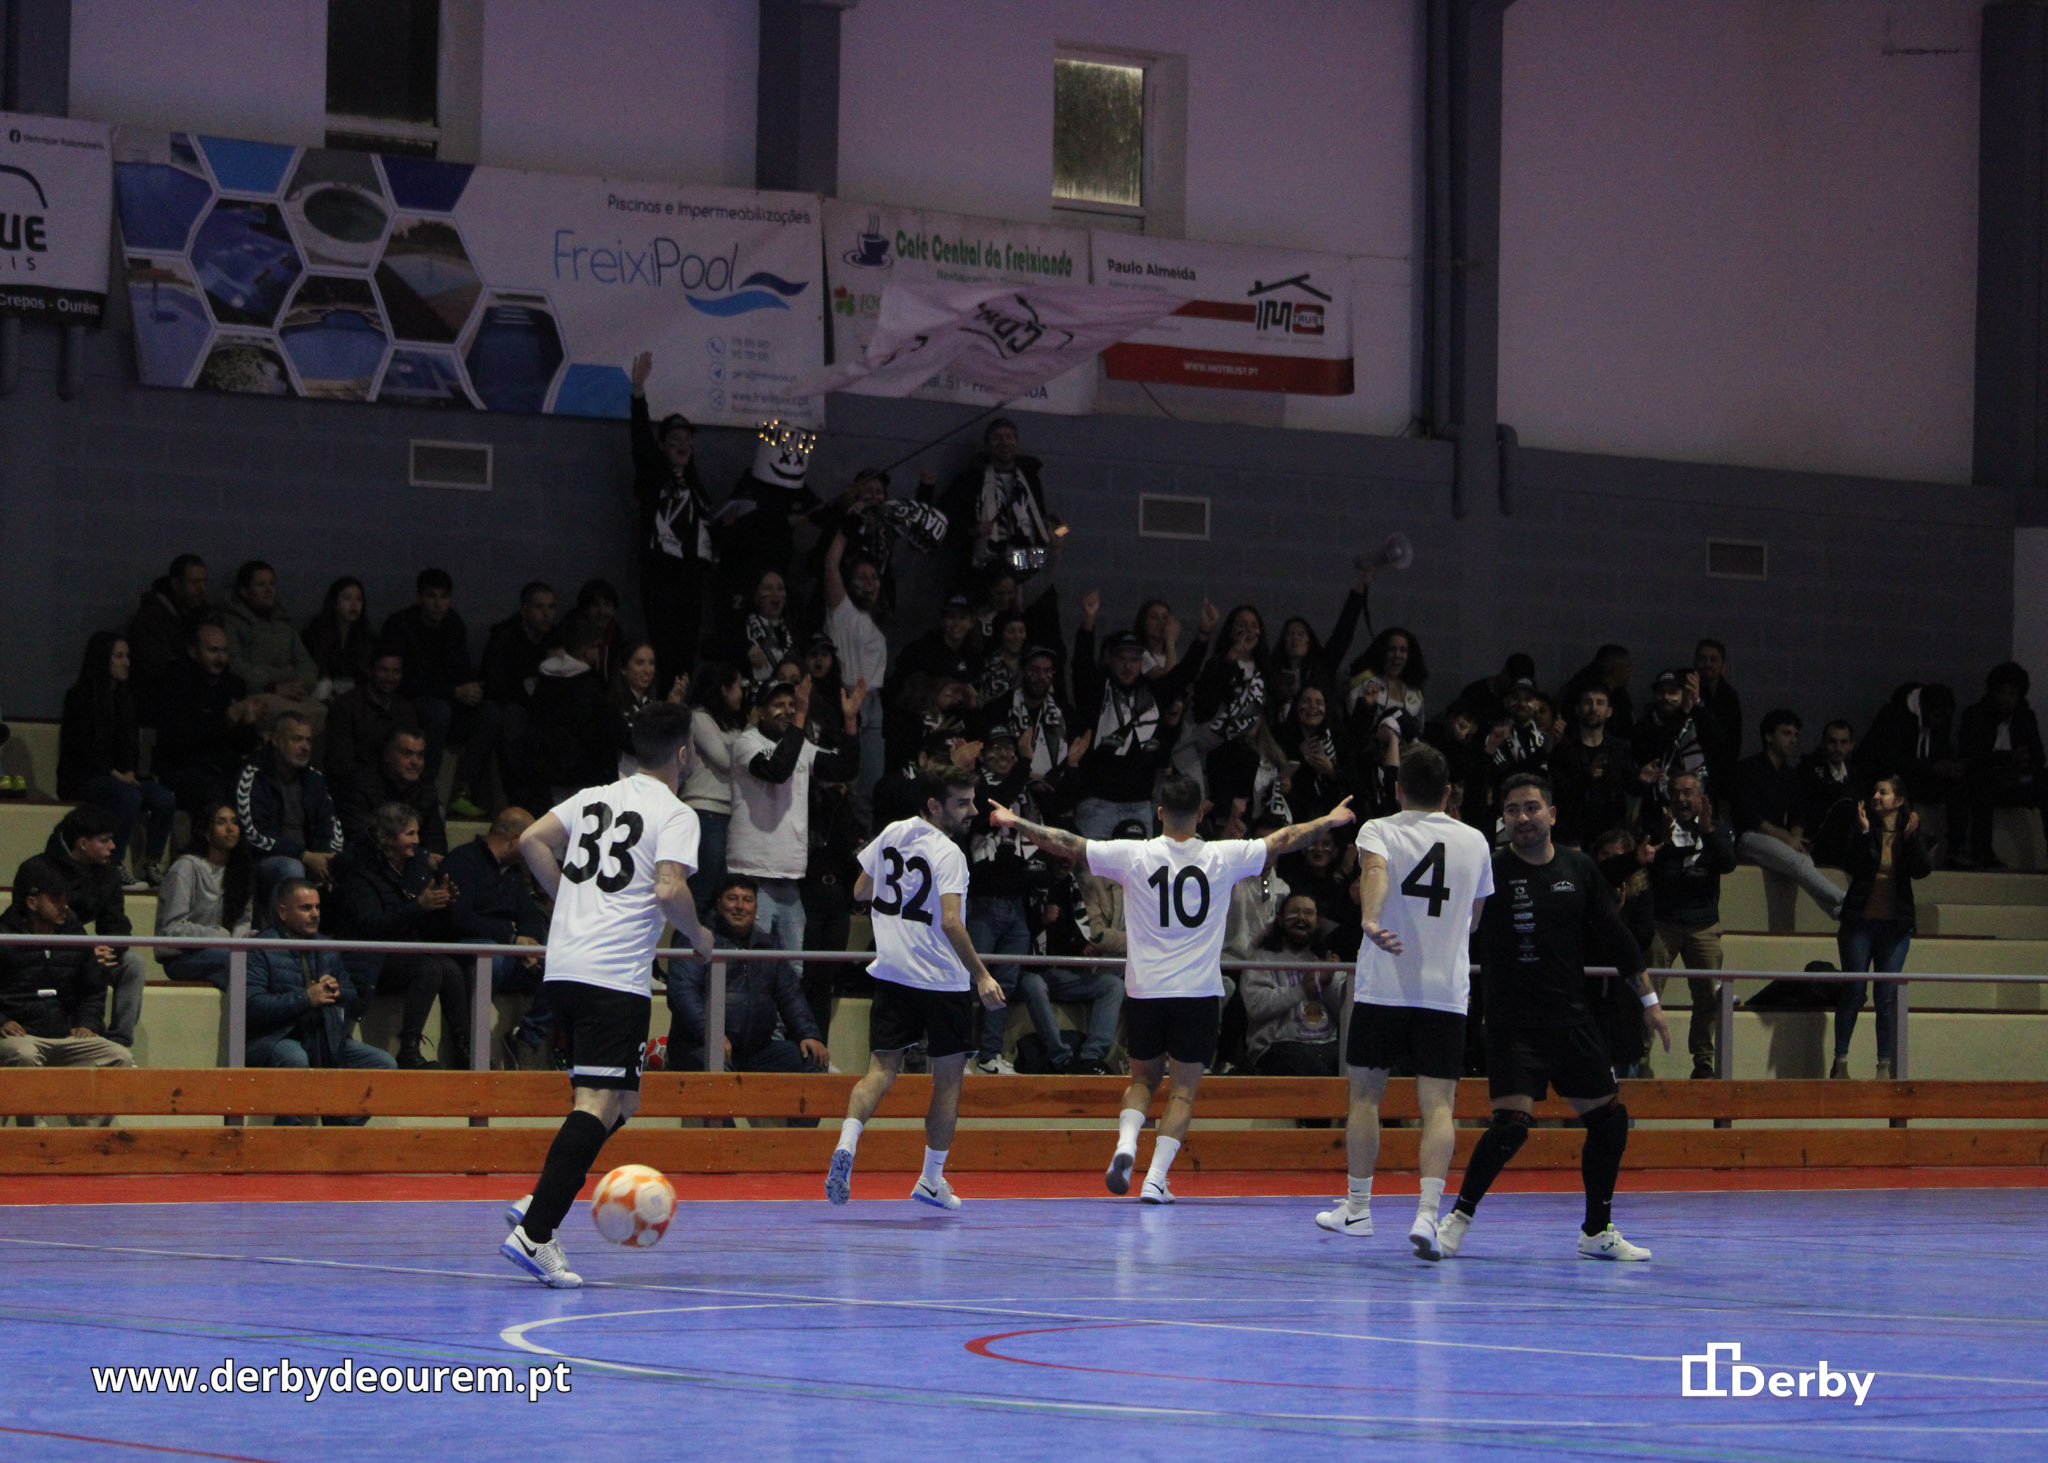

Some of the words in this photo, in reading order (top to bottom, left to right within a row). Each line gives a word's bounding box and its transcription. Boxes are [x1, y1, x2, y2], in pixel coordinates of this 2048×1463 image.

[607, 194, 661, 214] Piscinas
[665, 204, 674, 215] e
[678, 201, 811, 226] Impermeabilizações
[554, 229, 738, 292] FreixiPool
[932, 235, 981, 268] Central
[985, 241, 1001, 270] da
[1005, 243, 1073, 278] Freixianda
[1107, 259, 1144, 276] Paulo
[1146, 263, 1197, 281] Almeida
[562, 801, 644, 893] 33
[872, 847, 933, 926] 32
[1147, 865, 1210, 928] 10
[1401, 842, 1450, 917] 4
